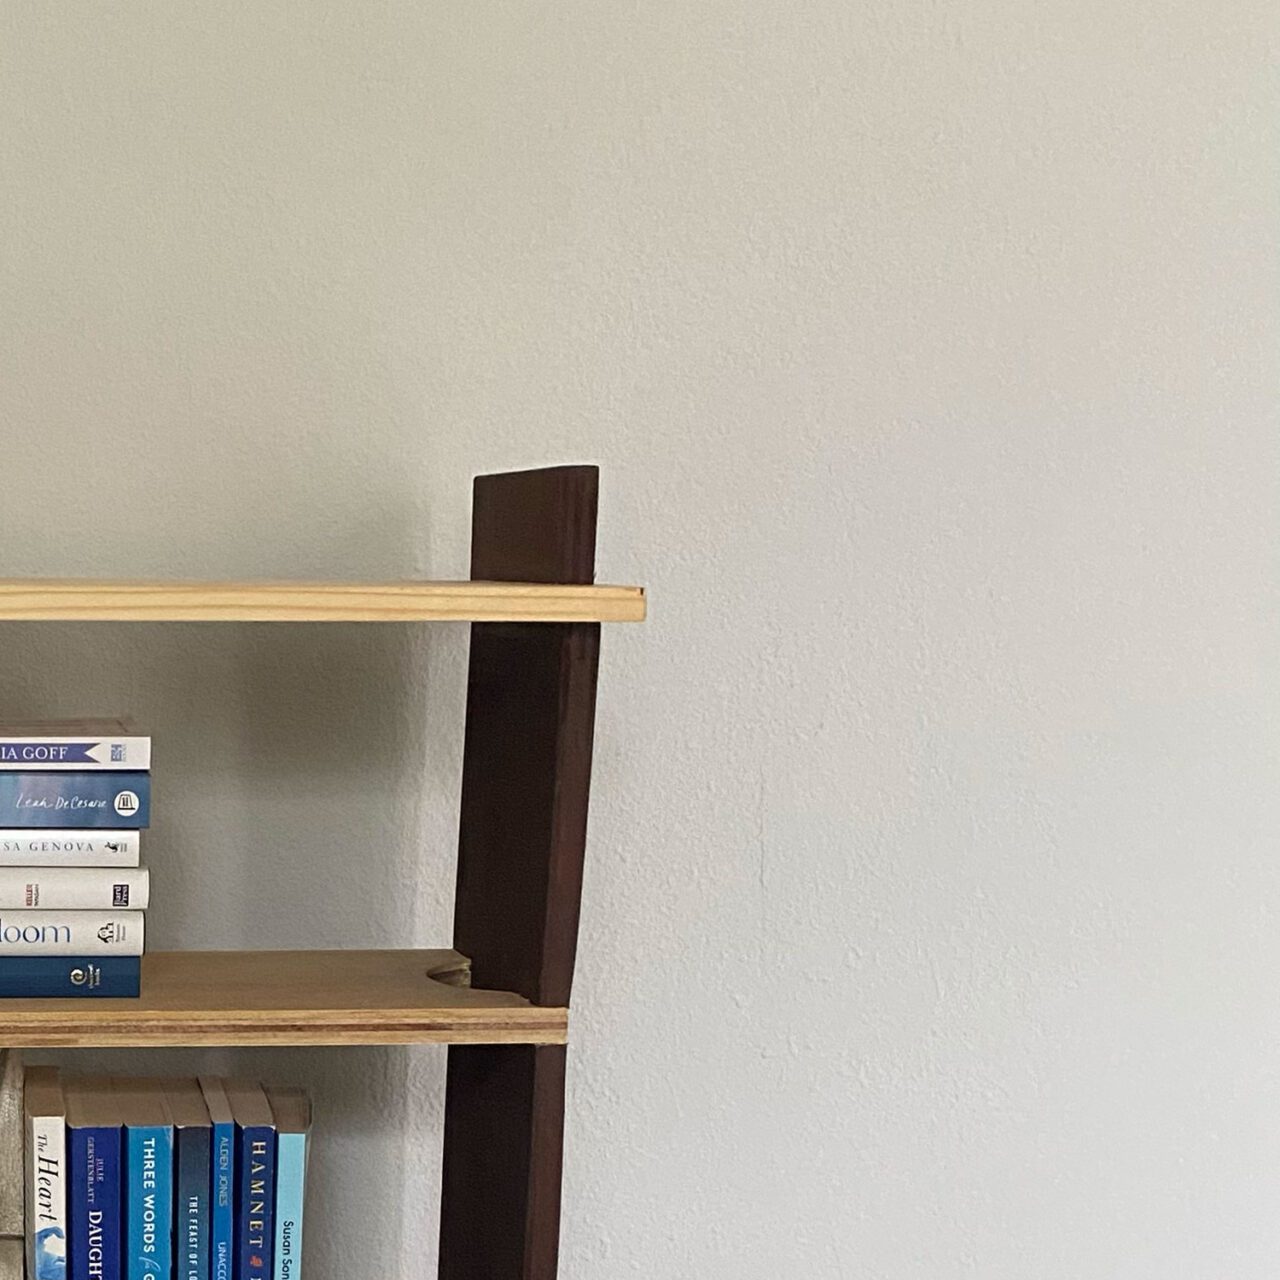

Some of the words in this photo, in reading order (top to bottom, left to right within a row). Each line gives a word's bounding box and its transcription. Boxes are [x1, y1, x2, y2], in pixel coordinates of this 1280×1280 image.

[22, 746, 69, 760] GOFF
[16, 793, 53, 808] Leah
[29, 841, 94, 852] GENOVA
[36, 1134, 47, 1153] The
[218, 1137, 229, 1170] ALDEN
[86, 1137, 95, 1204] GERSTENBLATT
[95, 1158, 104, 1182] JULIE
[142, 1137, 155, 1189] THREE
[37, 1155, 58, 1222] Heart
[217, 1174, 228, 1207] JONES
[248, 1141, 266, 1248] HAMNET
[187, 1196, 198, 1214] THE
[142, 1194, 155, 1253] WORDS
[187, 1218, 198, 1248] FEAST
[281, 1220, 294, 1256] Susan
[187, 1253, 198, 1265] OF
